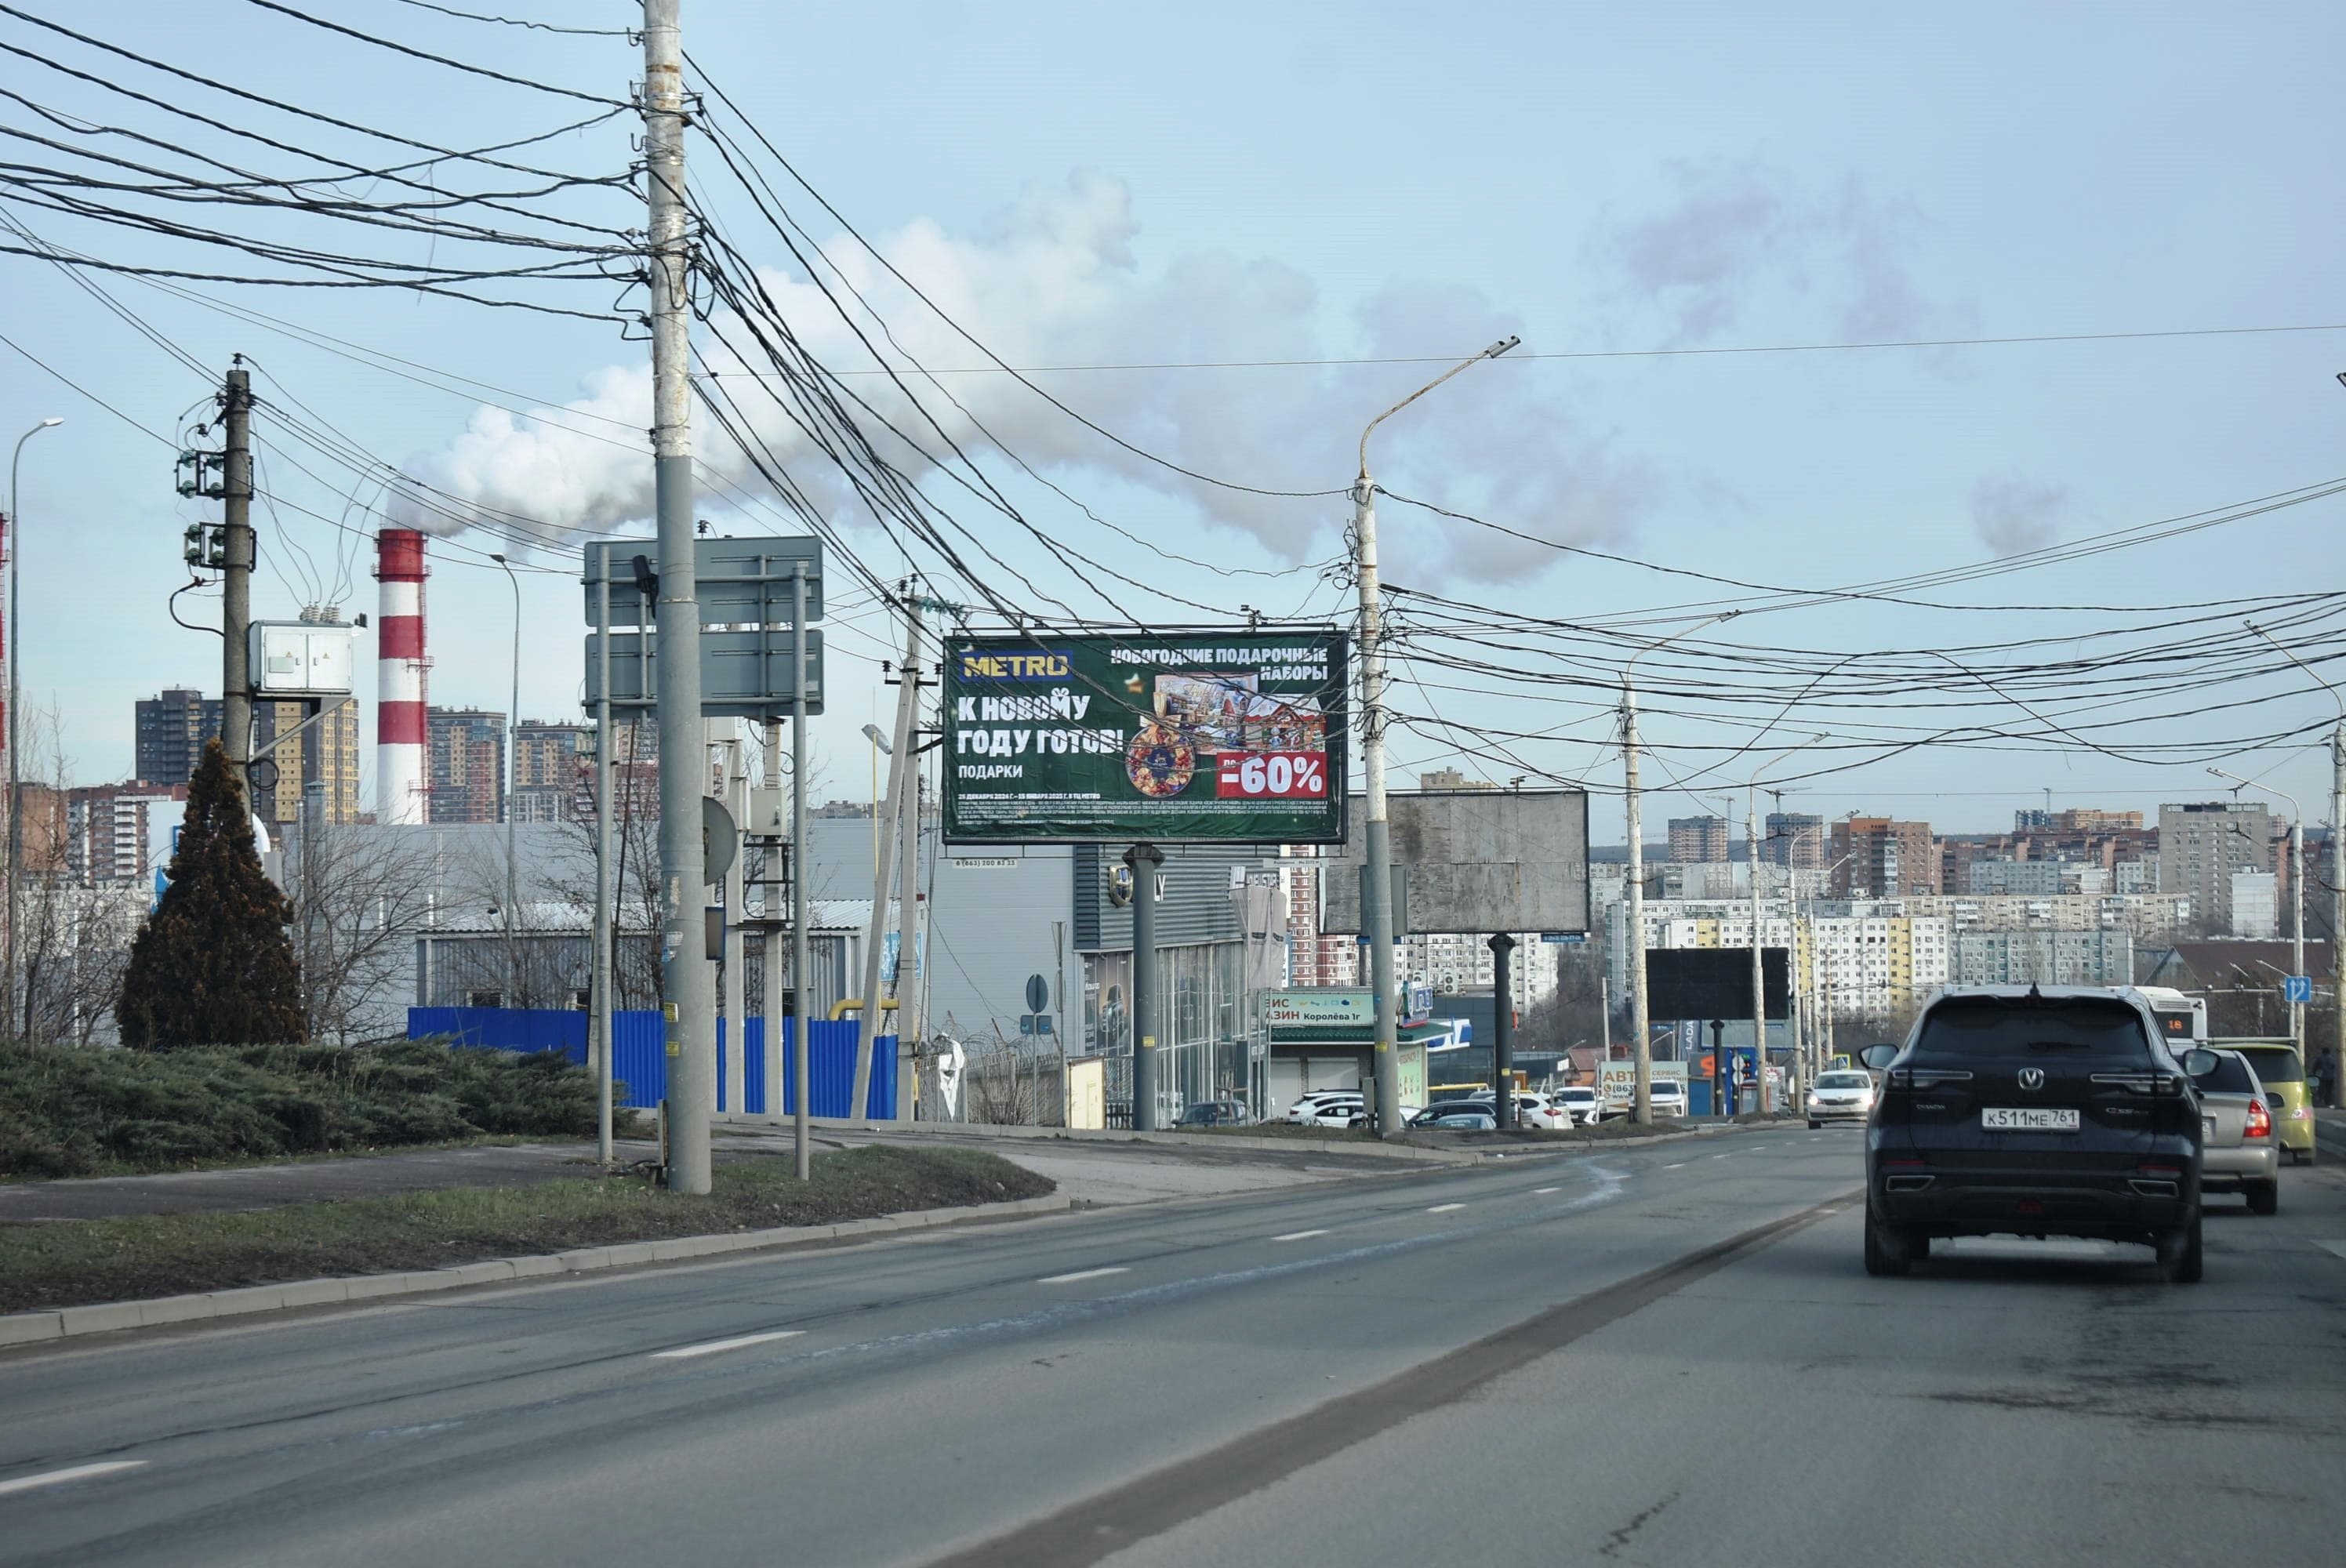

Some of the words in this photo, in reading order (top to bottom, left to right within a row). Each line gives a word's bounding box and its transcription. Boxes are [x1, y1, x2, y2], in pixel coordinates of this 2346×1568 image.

[964, 655, 1068, 677] METRO
[1110, 648, 1213, 666] НОВОГОДНИЕ
[1216, 648, 1328, 666] ПОДАРОЧНЫЕ
[1261, 666, 1328, 681] НАБОРЫ
[958, 696, 977, 721] К
[982, 695, 1091, 721] НОВОМУ
[957, 729, 1032, 757] ГОДУ
[1037, 729, 1124, 753] ГОТОВ!
[958, 765, 1022, 780] ПОДАРКИ
[1222, 756, 1323, 793] -60%
[1304, 1012, 1349, 1022] Королёва
[1685, 1021, 1694, 1050] LADA
[1987, 1110, 2048, 1127] К511МЕ
[2052, 1110, 2076, 1123] 761
